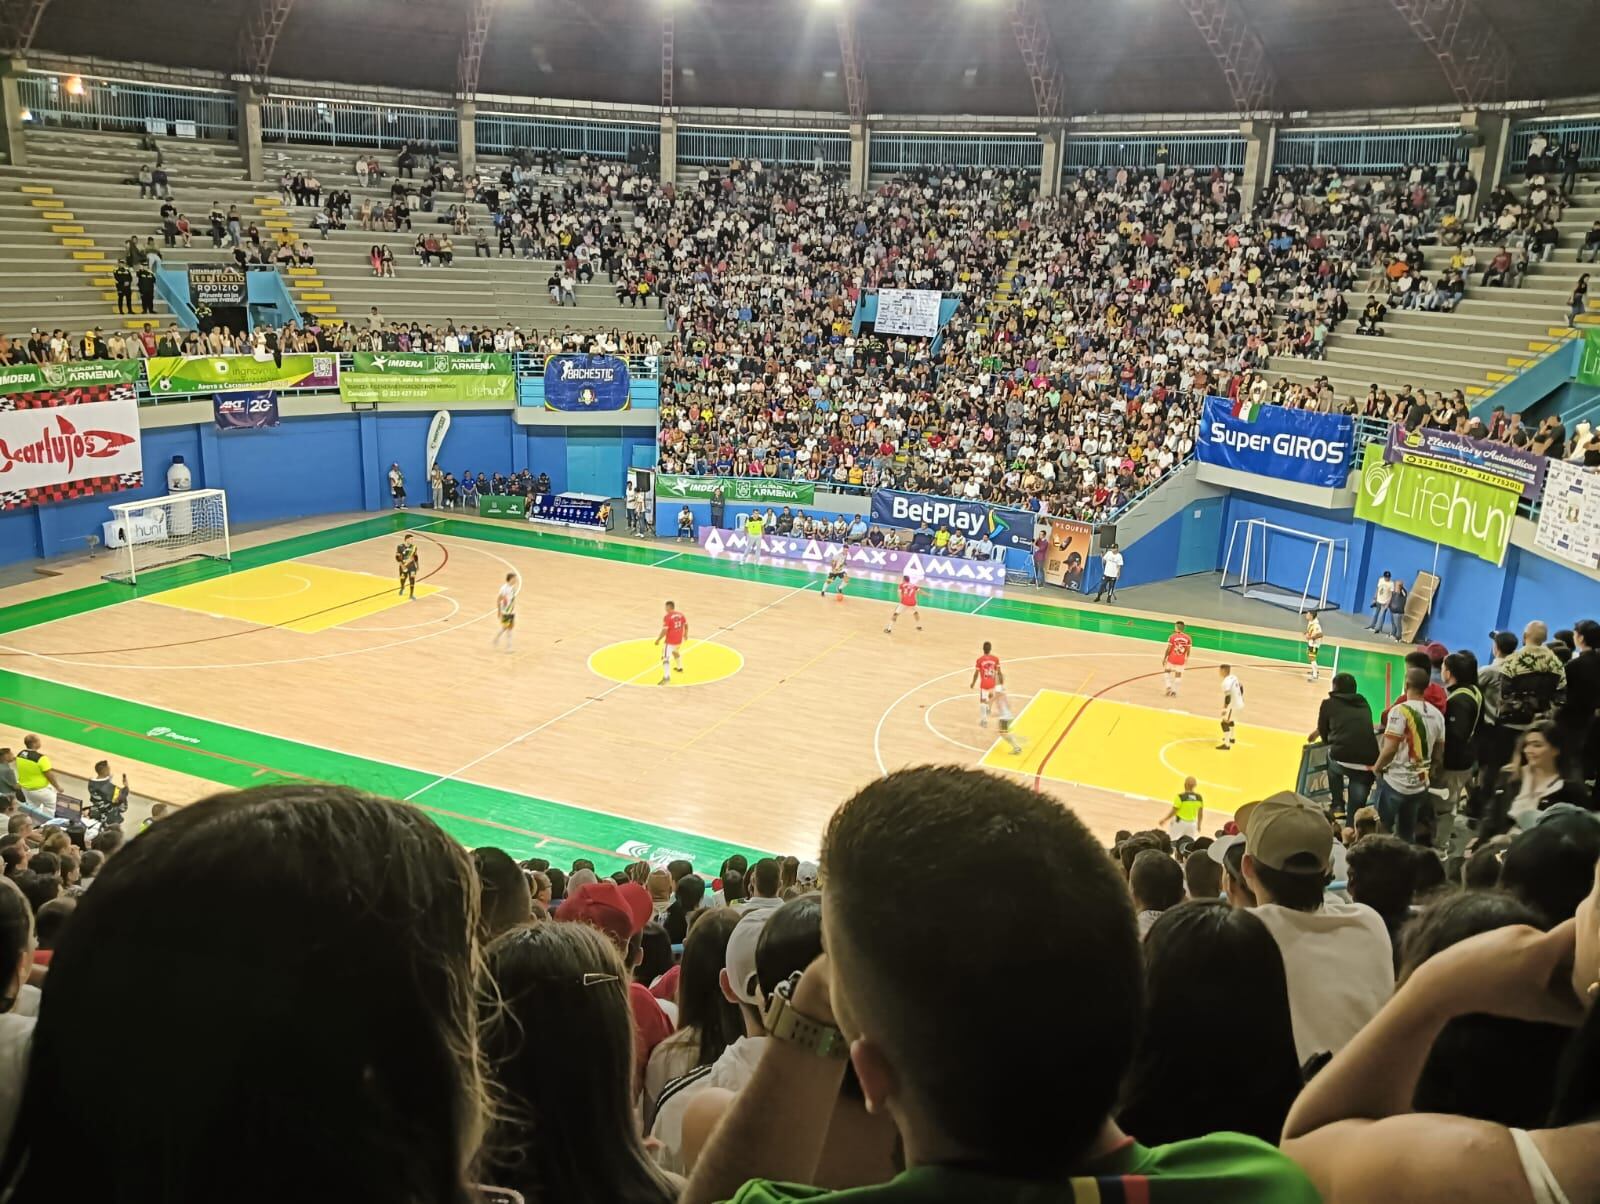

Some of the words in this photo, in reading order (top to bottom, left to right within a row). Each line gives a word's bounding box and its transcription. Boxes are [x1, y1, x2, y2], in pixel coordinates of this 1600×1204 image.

[197, 284, 239, 292] RODIZIO
[388, 360, 424, 369] IMDERA
[451, 361, 496, 370] ARMENIA
[69, 369, 122, 381] ARMENIA
[1211, 422, 1271, 452] Super
[1273, 433, 1346, 464] GIROS
[753, 488, 798, 498] ARMENIA
[892, 496, 985, 536] BetPlay
